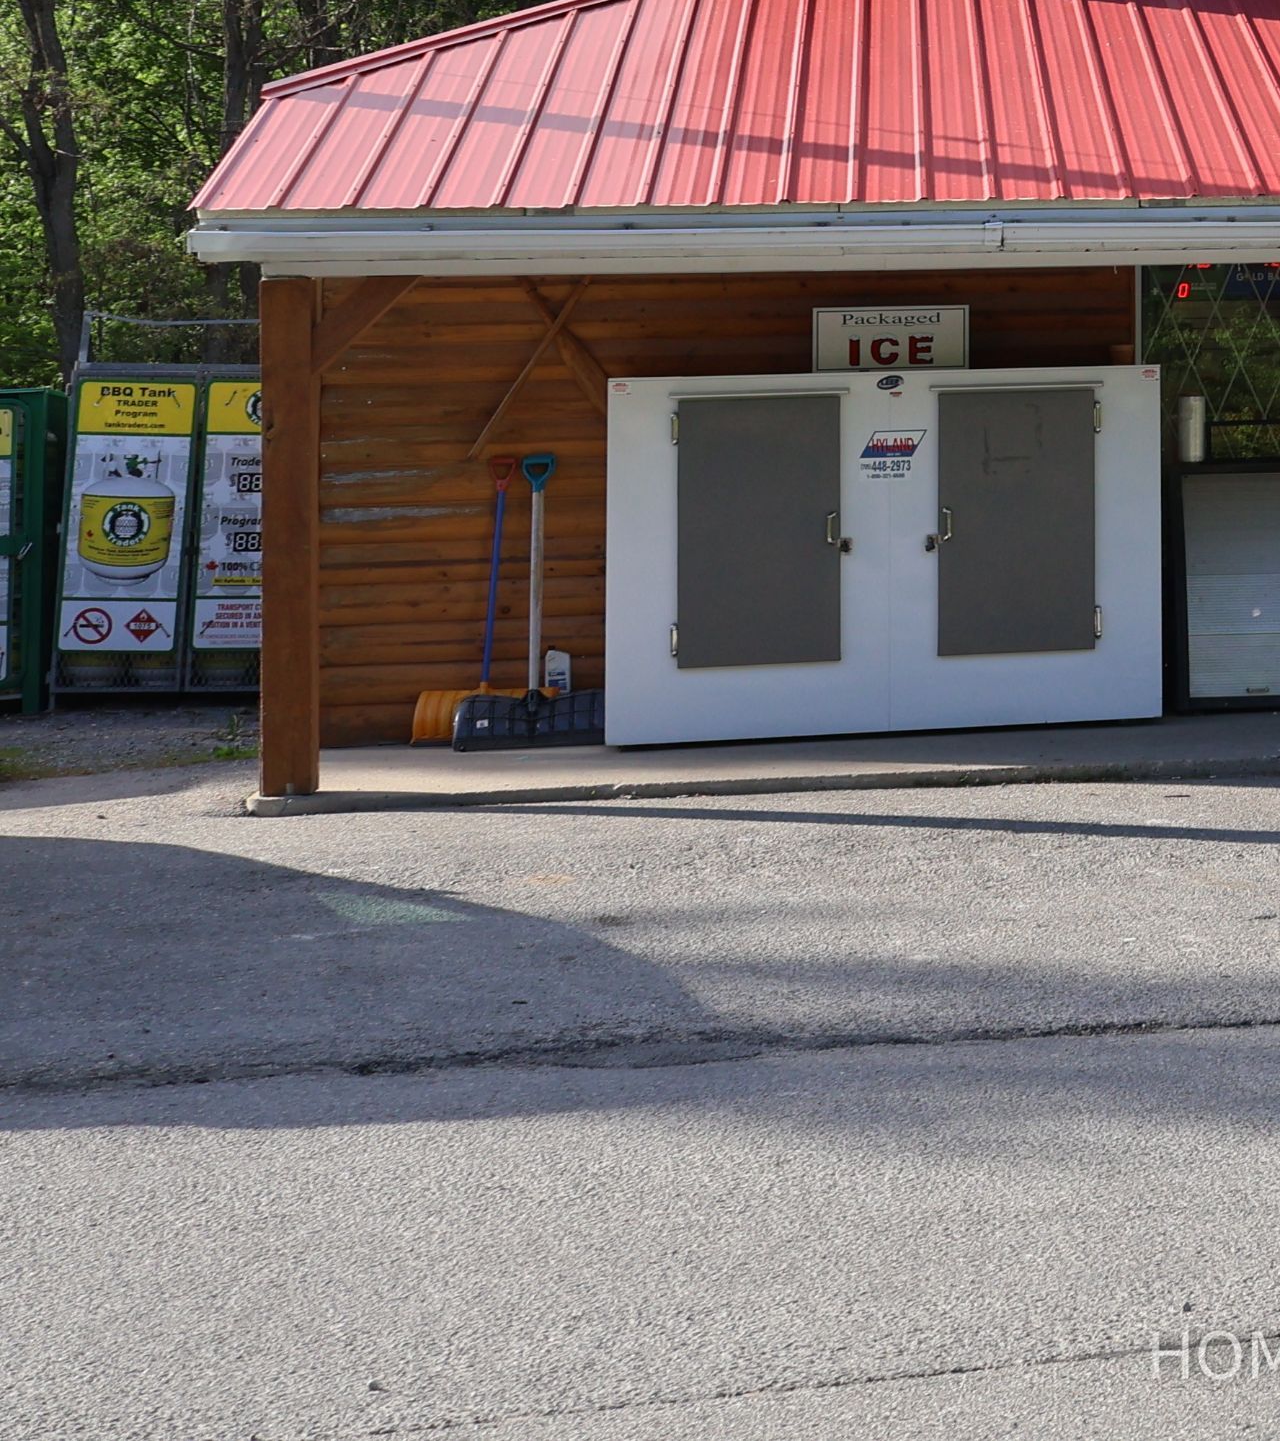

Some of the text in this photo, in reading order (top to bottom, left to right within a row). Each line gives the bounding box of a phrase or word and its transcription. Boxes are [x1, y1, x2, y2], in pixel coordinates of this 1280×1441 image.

[841, 312, 940, 326] Packaged
[849, 333, 934, 366] ICE
[100, 386, 176, 397] BBQ Tank
[114, 409, 157, 418] Program
[871, 438, 915, 453] HYLAND
[231, 457, 261, 466] Trade
[114, 504, 140, 512] Tank
[107, 533, 145, 546] Traders
[221, 562, 248, 571] 100%
